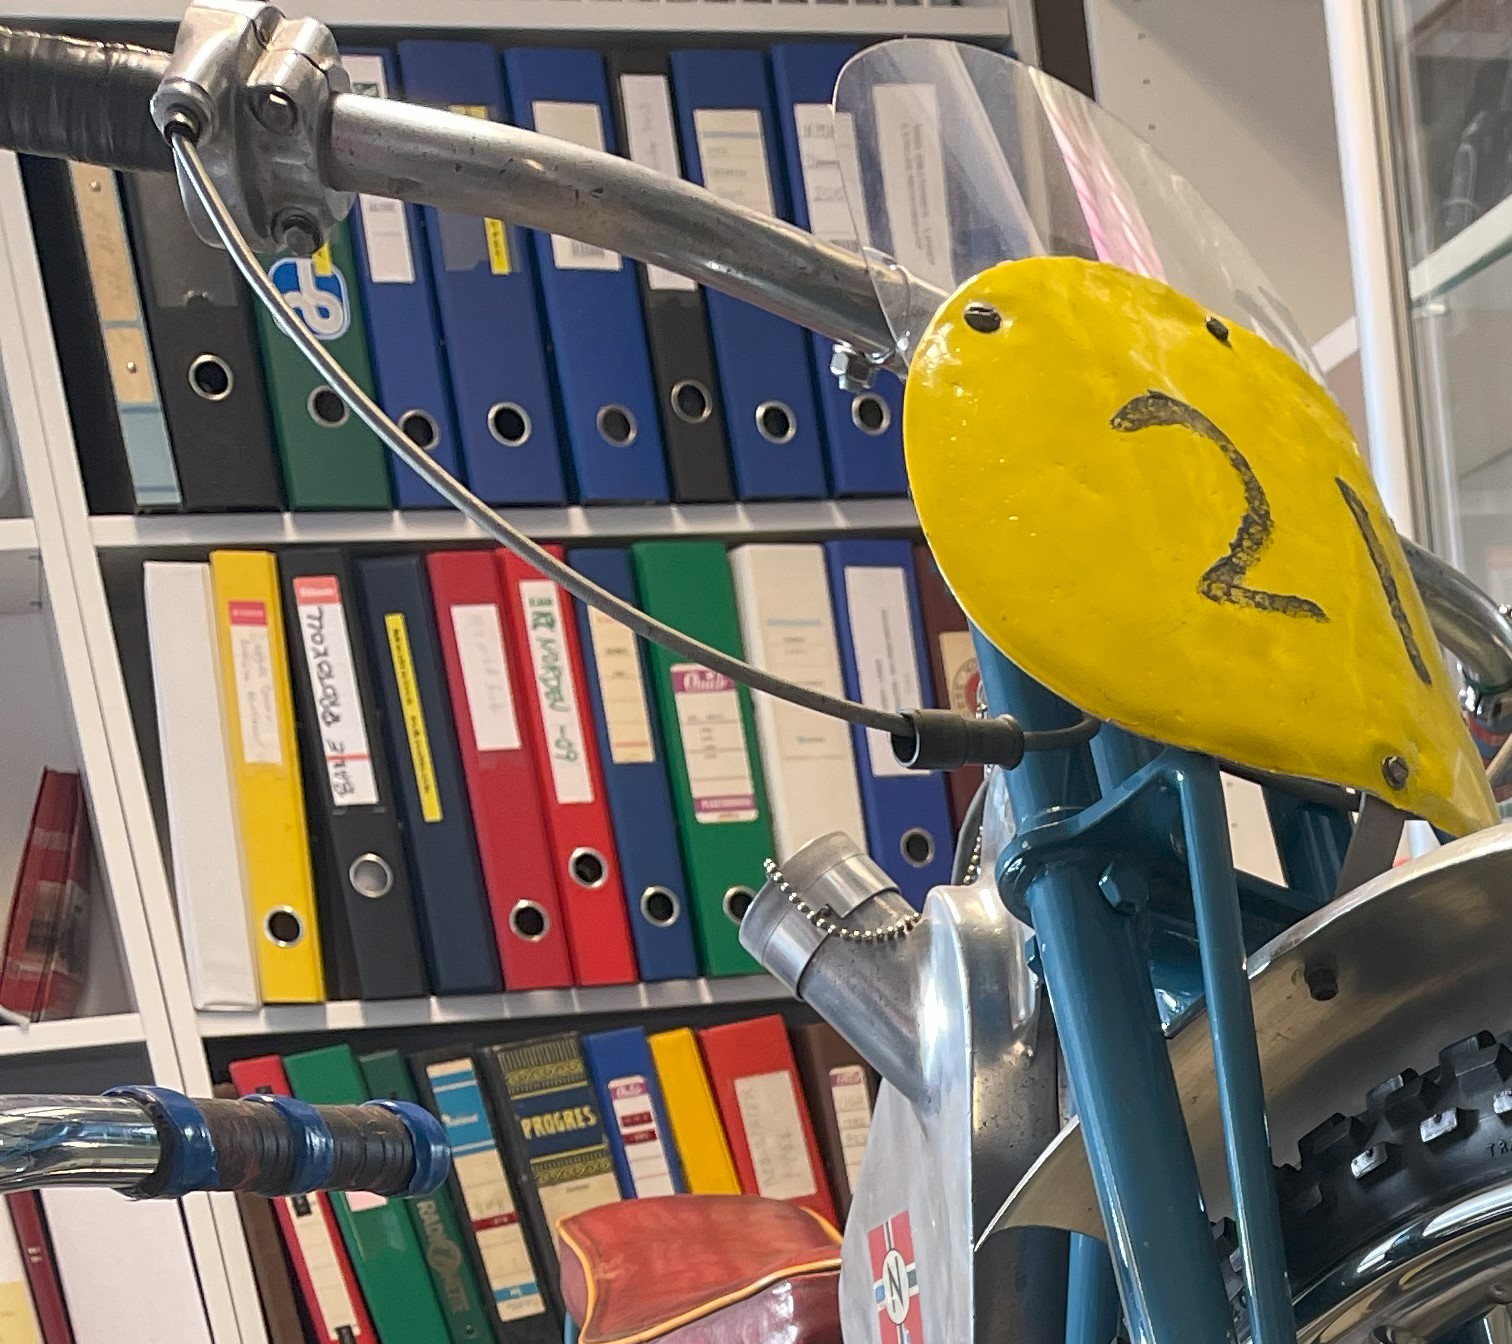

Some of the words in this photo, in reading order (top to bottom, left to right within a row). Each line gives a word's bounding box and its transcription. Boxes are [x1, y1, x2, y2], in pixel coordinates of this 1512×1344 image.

[1110, 389, 1431, 686] 21
[304, 606, 342, 728] PROTOKOLL
[521, 1106, 598, 1141] PROGRES
[885, 1256, 905, 1315] N
